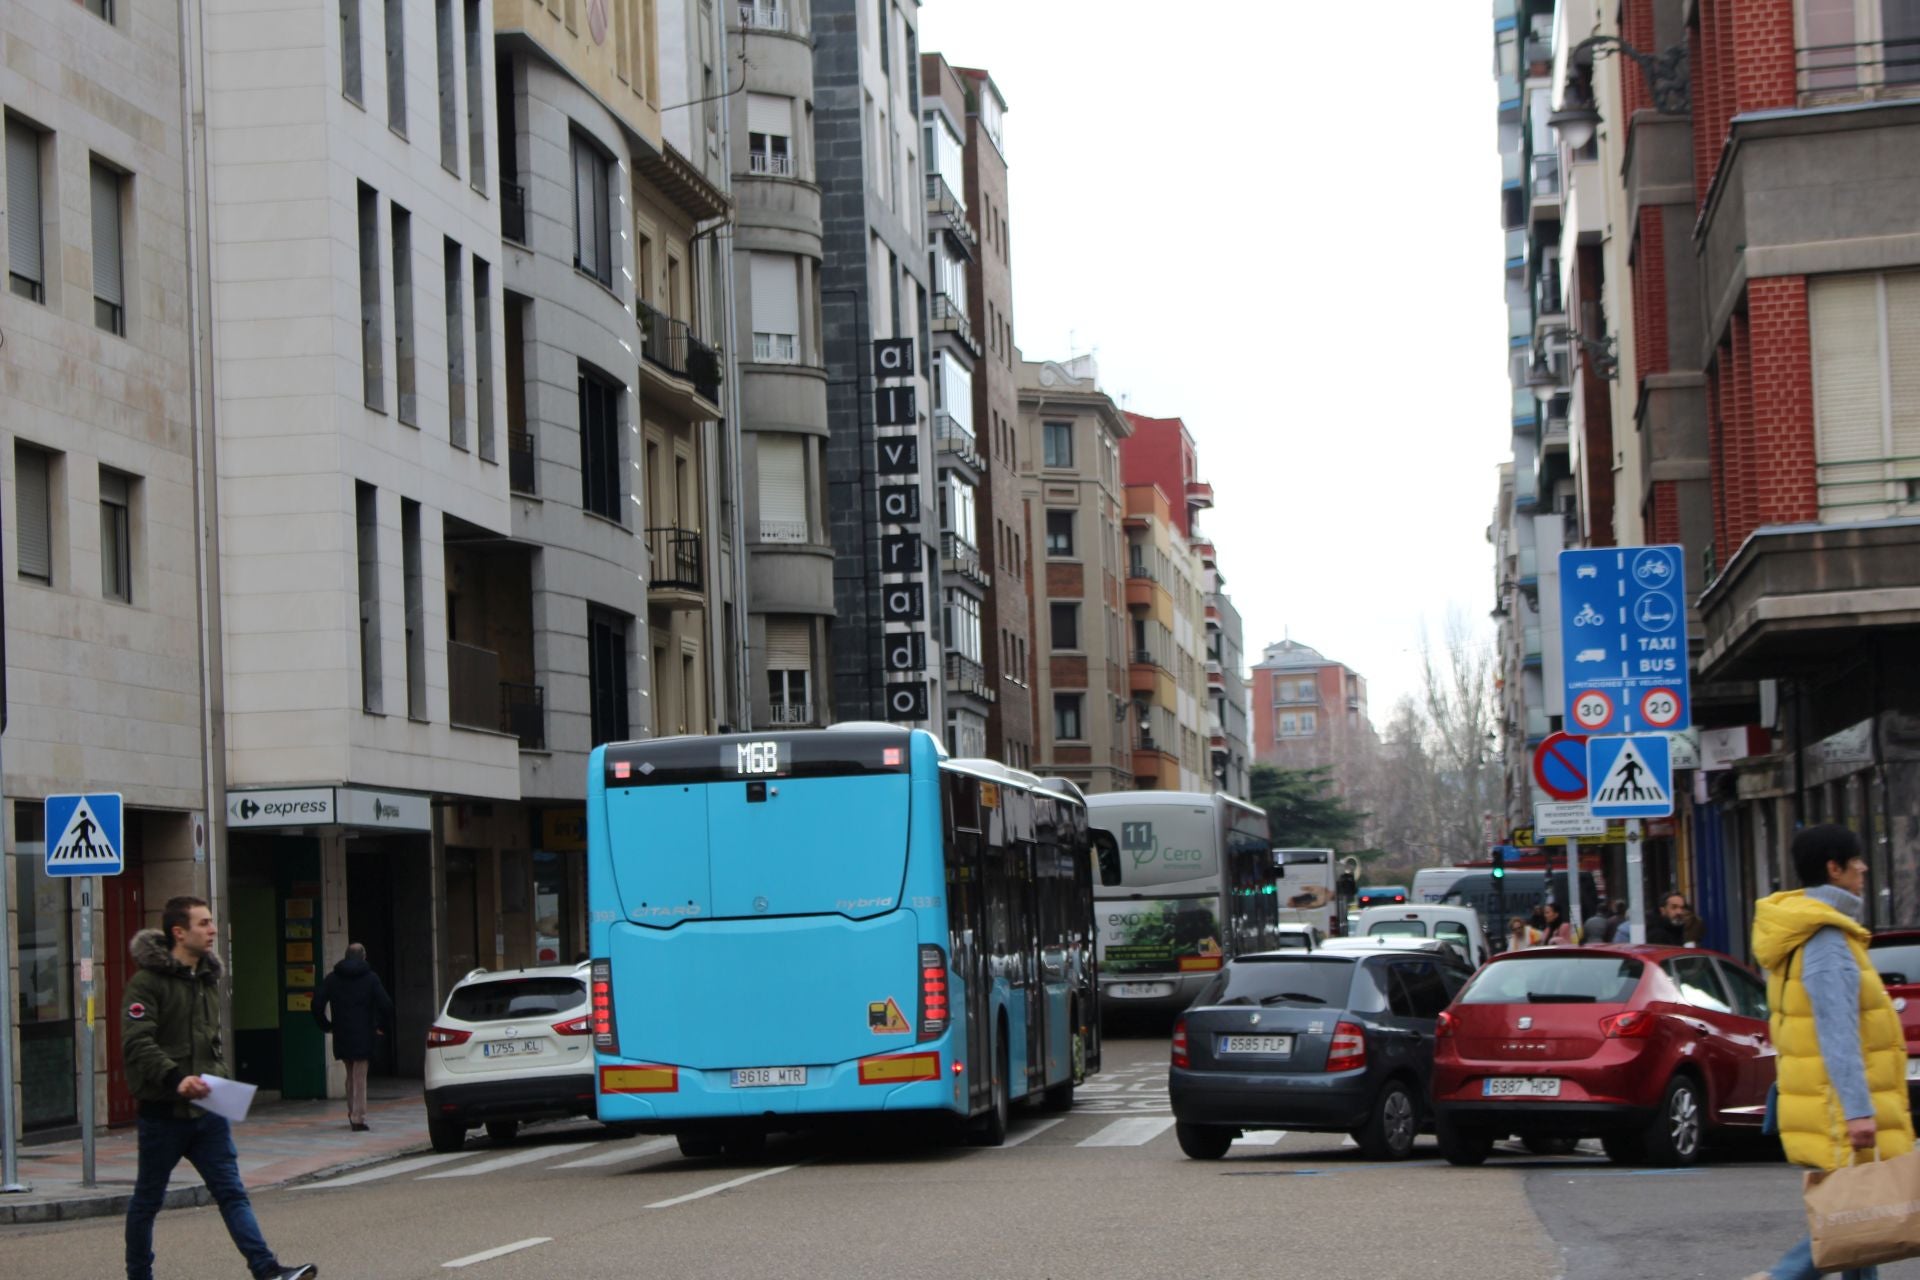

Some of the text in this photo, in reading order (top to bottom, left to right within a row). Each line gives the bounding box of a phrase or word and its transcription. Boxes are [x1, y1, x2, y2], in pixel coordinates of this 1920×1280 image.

[880, 346, 915, 713] alvarado
[1638, 637, 1677, 651] TAXI
[1639, 658, 1676, 673] BUS
[1580, 703, 1604, 718] 30
[1649, 701, 1672, 715] 20
[736, 741, 777, 774] M6B
[264, 799, 327, 817] express
[1125, 824, 1149, 843] 11
[1163, 846, 1202, 862] Cero
[631, 904, 702, 918] CITARO
[836, 897, 893, 910] hybrid
[491, 1041, 516, 1054] 1755
[1230, 1038, 1286, 1051] 6585 FLP
[739, 1068, 801, 1083] 9618 MTR
[1491, 1080, 1557, 1093] 6987 HCP
